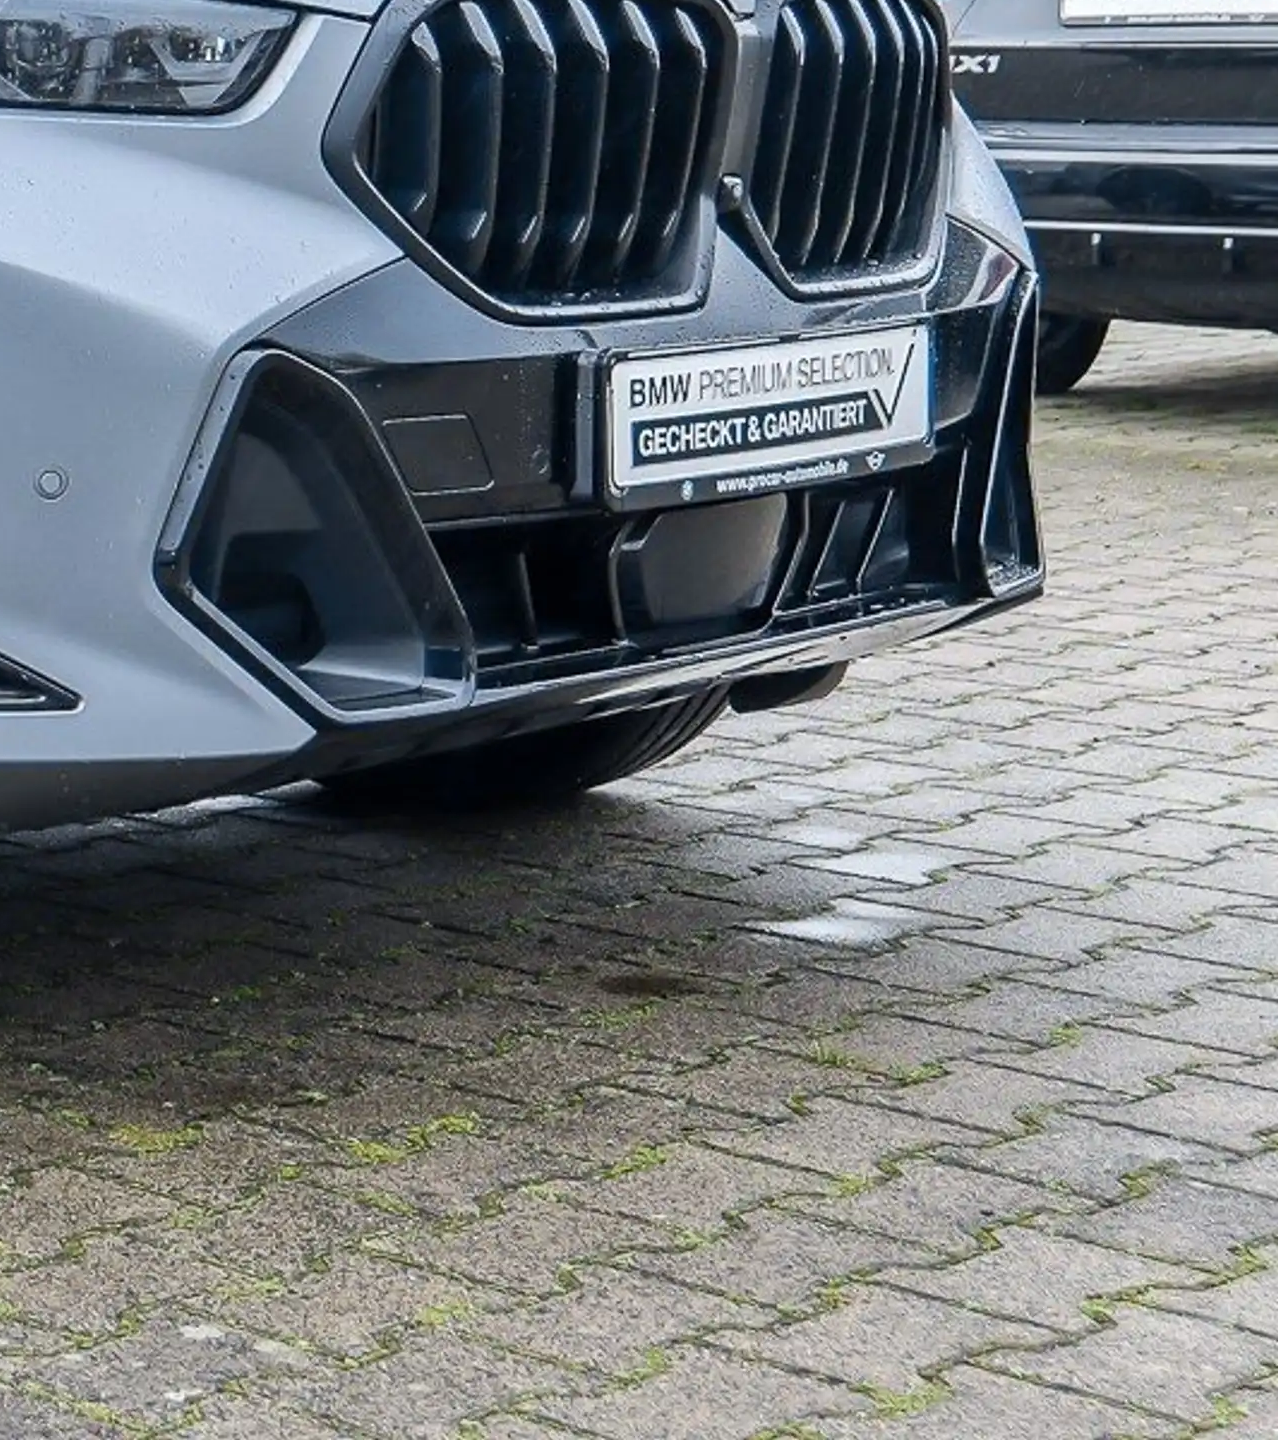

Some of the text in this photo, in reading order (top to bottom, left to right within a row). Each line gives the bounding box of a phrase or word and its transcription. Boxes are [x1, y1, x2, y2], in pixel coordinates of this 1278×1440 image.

[630, 372, 691, 408] BMW
[699, 361, 792, 401] PREMIUM
[639, 399, 868, 457] GECHECKT & GARANTIERT
